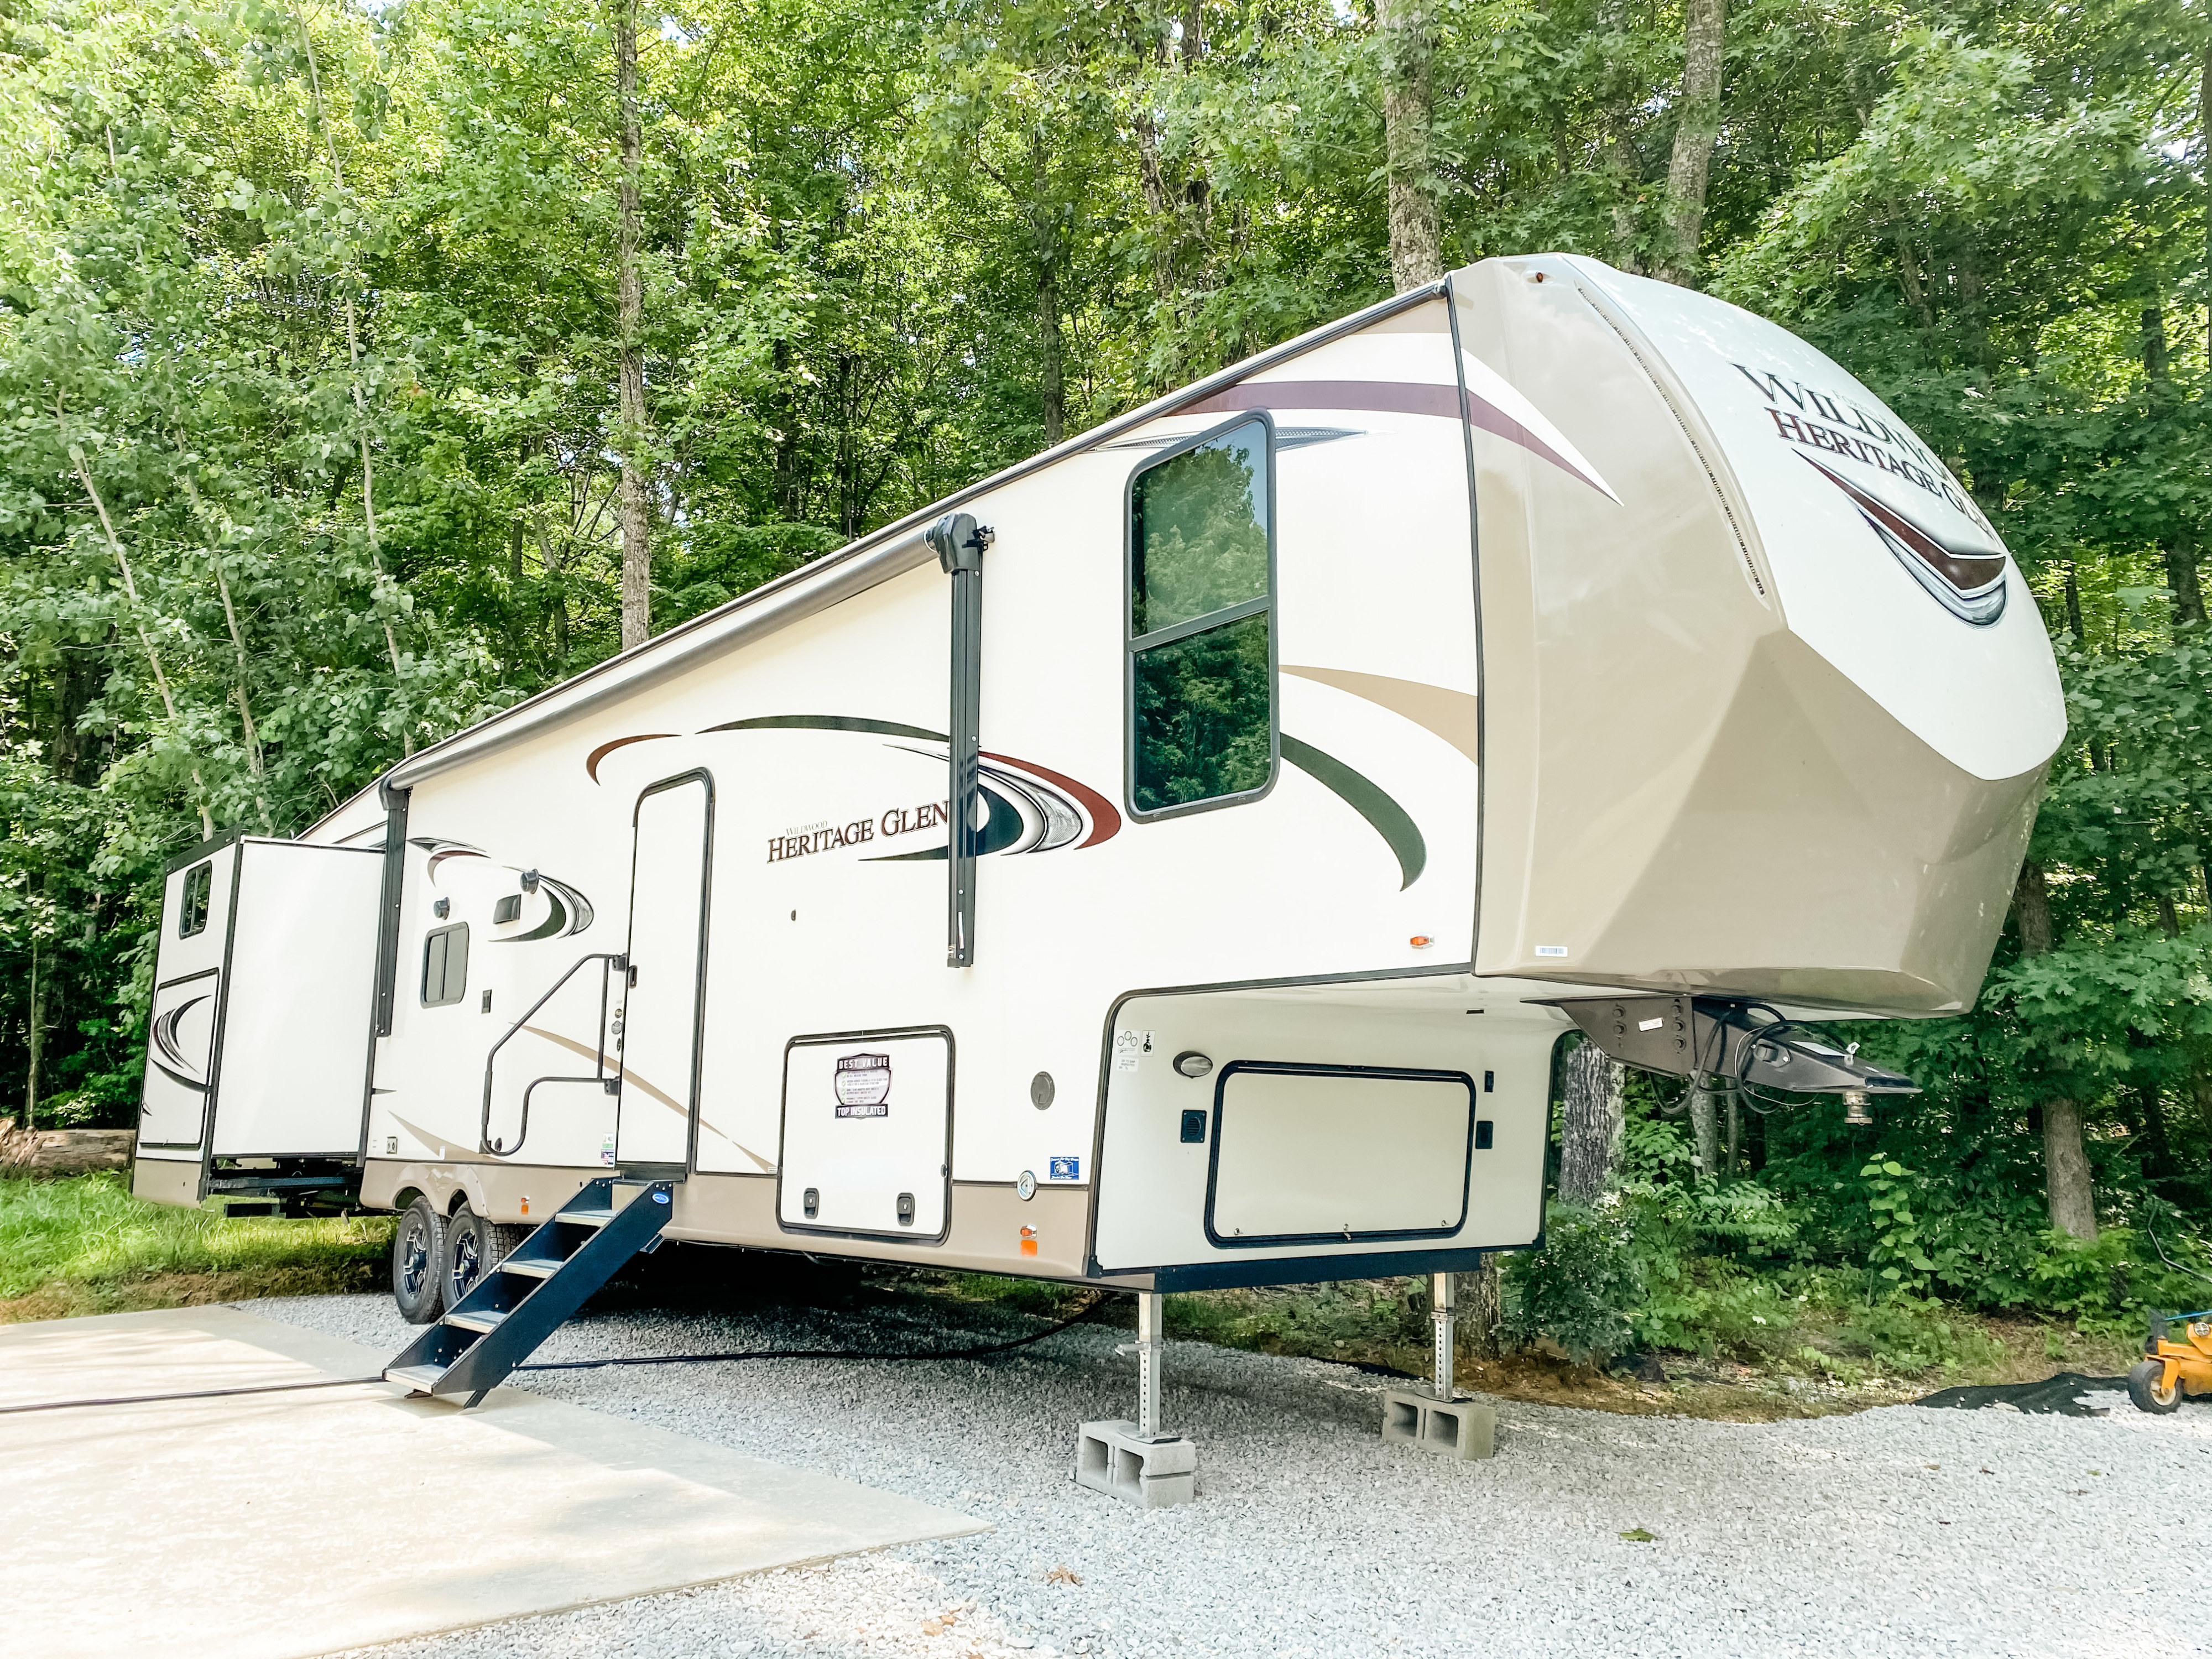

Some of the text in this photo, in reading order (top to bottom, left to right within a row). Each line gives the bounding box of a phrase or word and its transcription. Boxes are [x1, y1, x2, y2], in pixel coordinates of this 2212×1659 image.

[1764, 406, 1944, 499] HERITAGE
[766, 799, 949, 864] HERITAGE GLEN
[785, 820, 828, 837] WILDWOOD
[838, 1057, 888, 1070] BEST VALUE
[837, 1106, 886, 1117] TOP INSULATED
